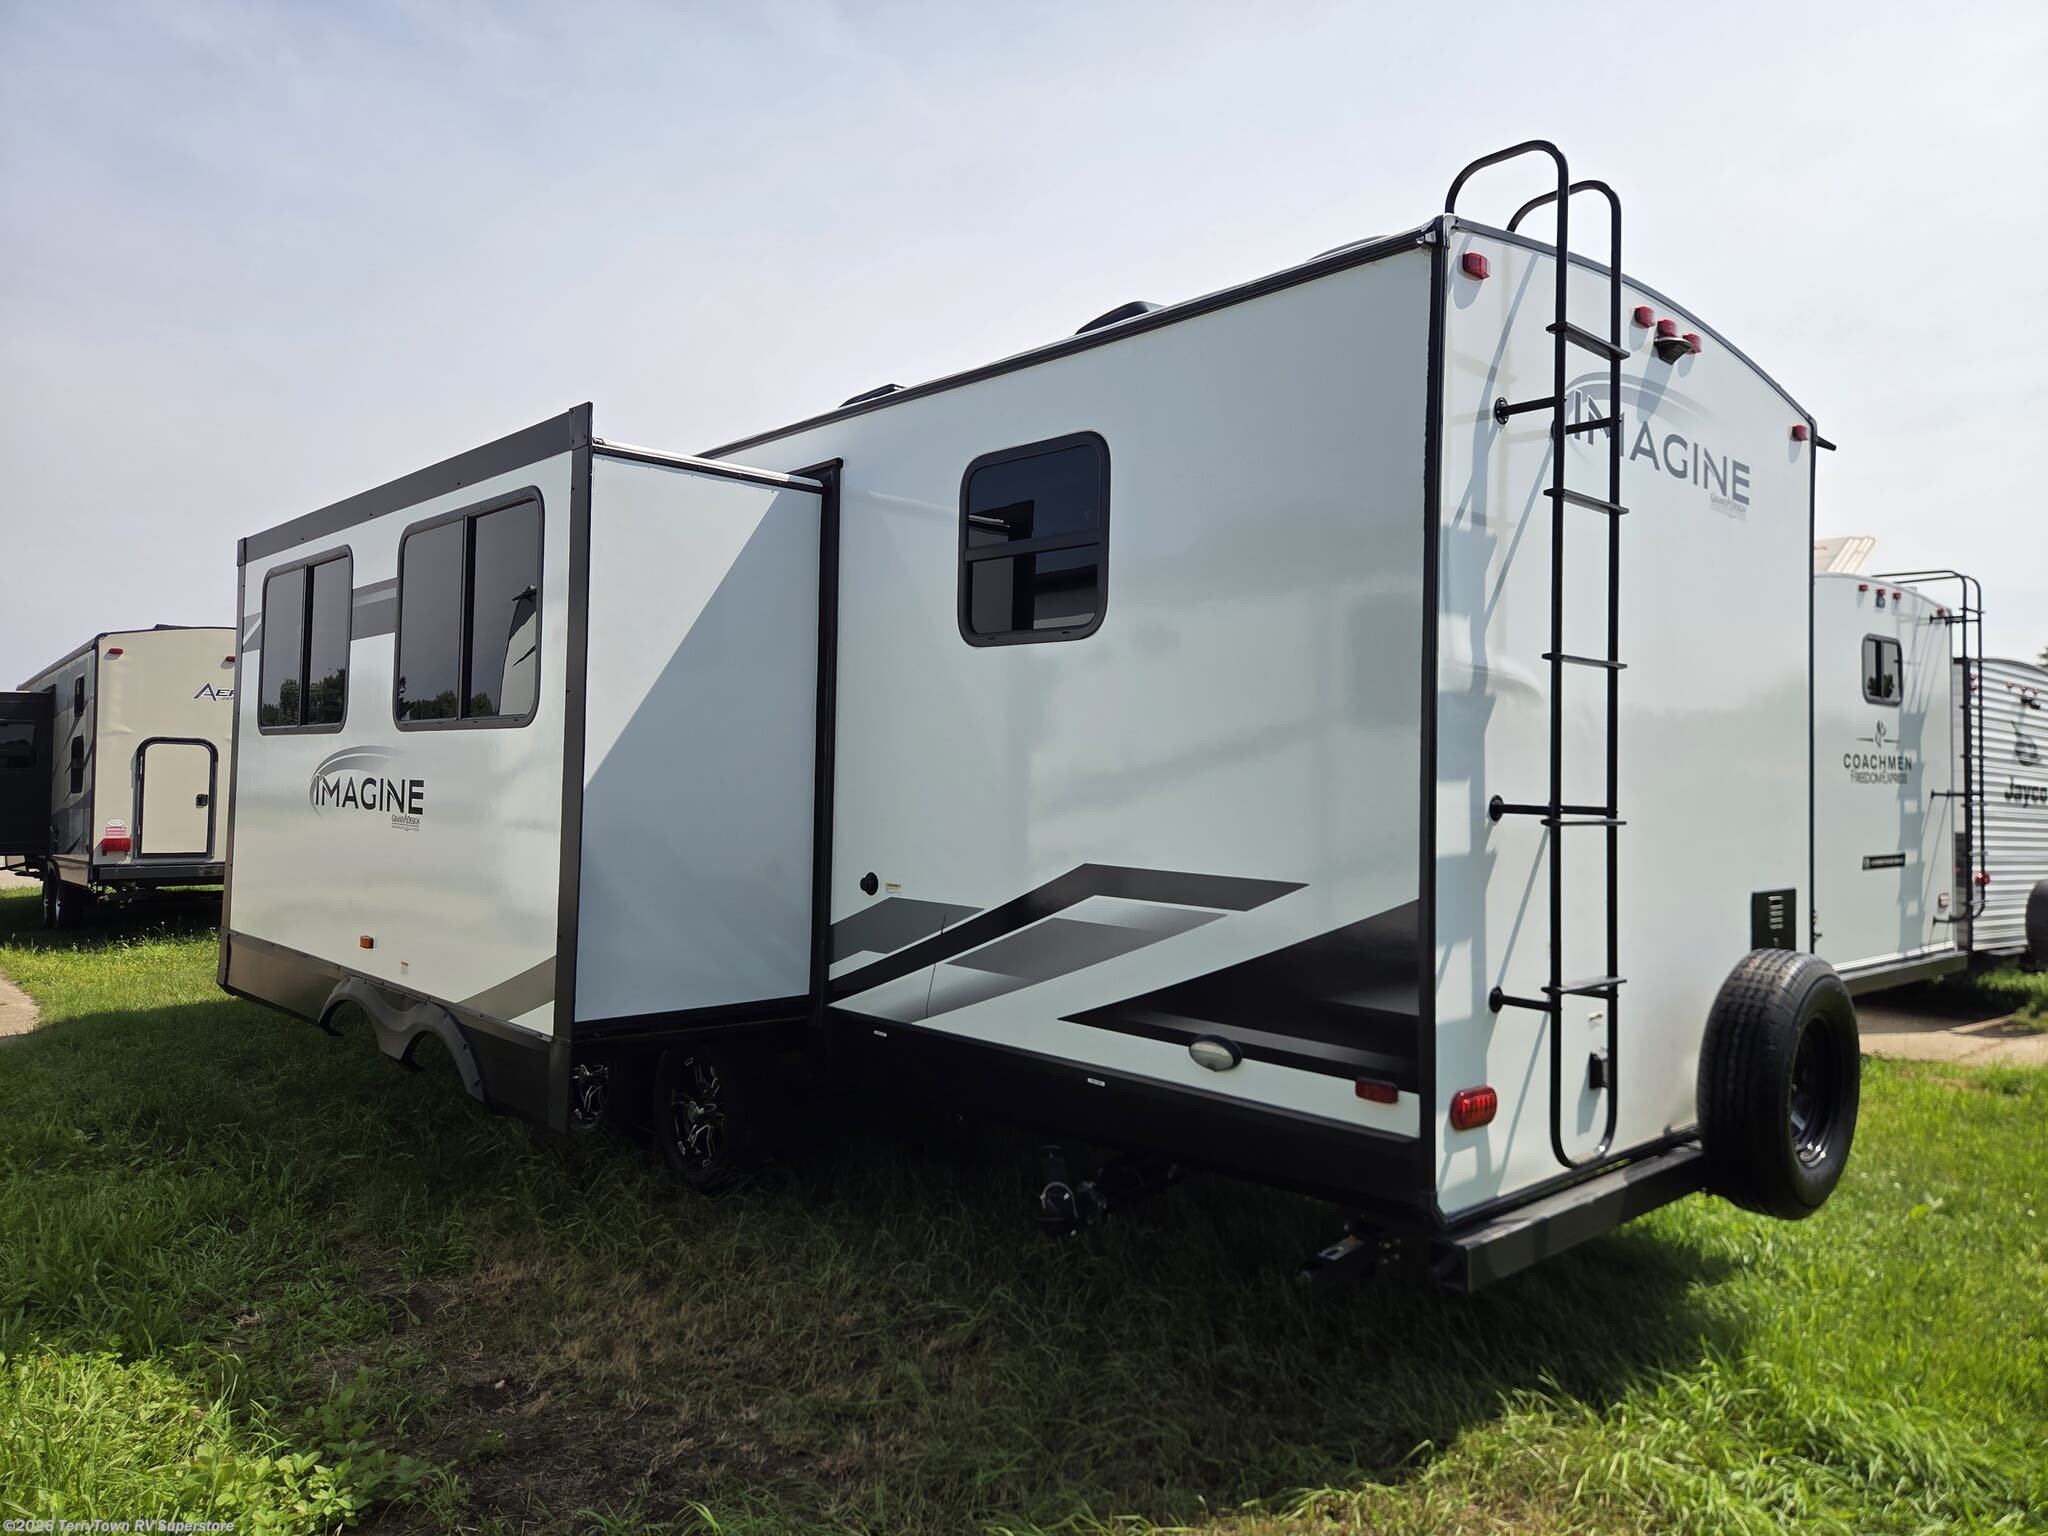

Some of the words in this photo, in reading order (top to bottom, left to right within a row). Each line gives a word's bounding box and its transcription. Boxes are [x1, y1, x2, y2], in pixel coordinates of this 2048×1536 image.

[1574, 390, 1750, 505] IMAGINE
[1843, 753, 1912, 771] COACHMEN
[315, 774, 424, 815] IMAGINE
[2004, 776, 2047, 808] Jayco
